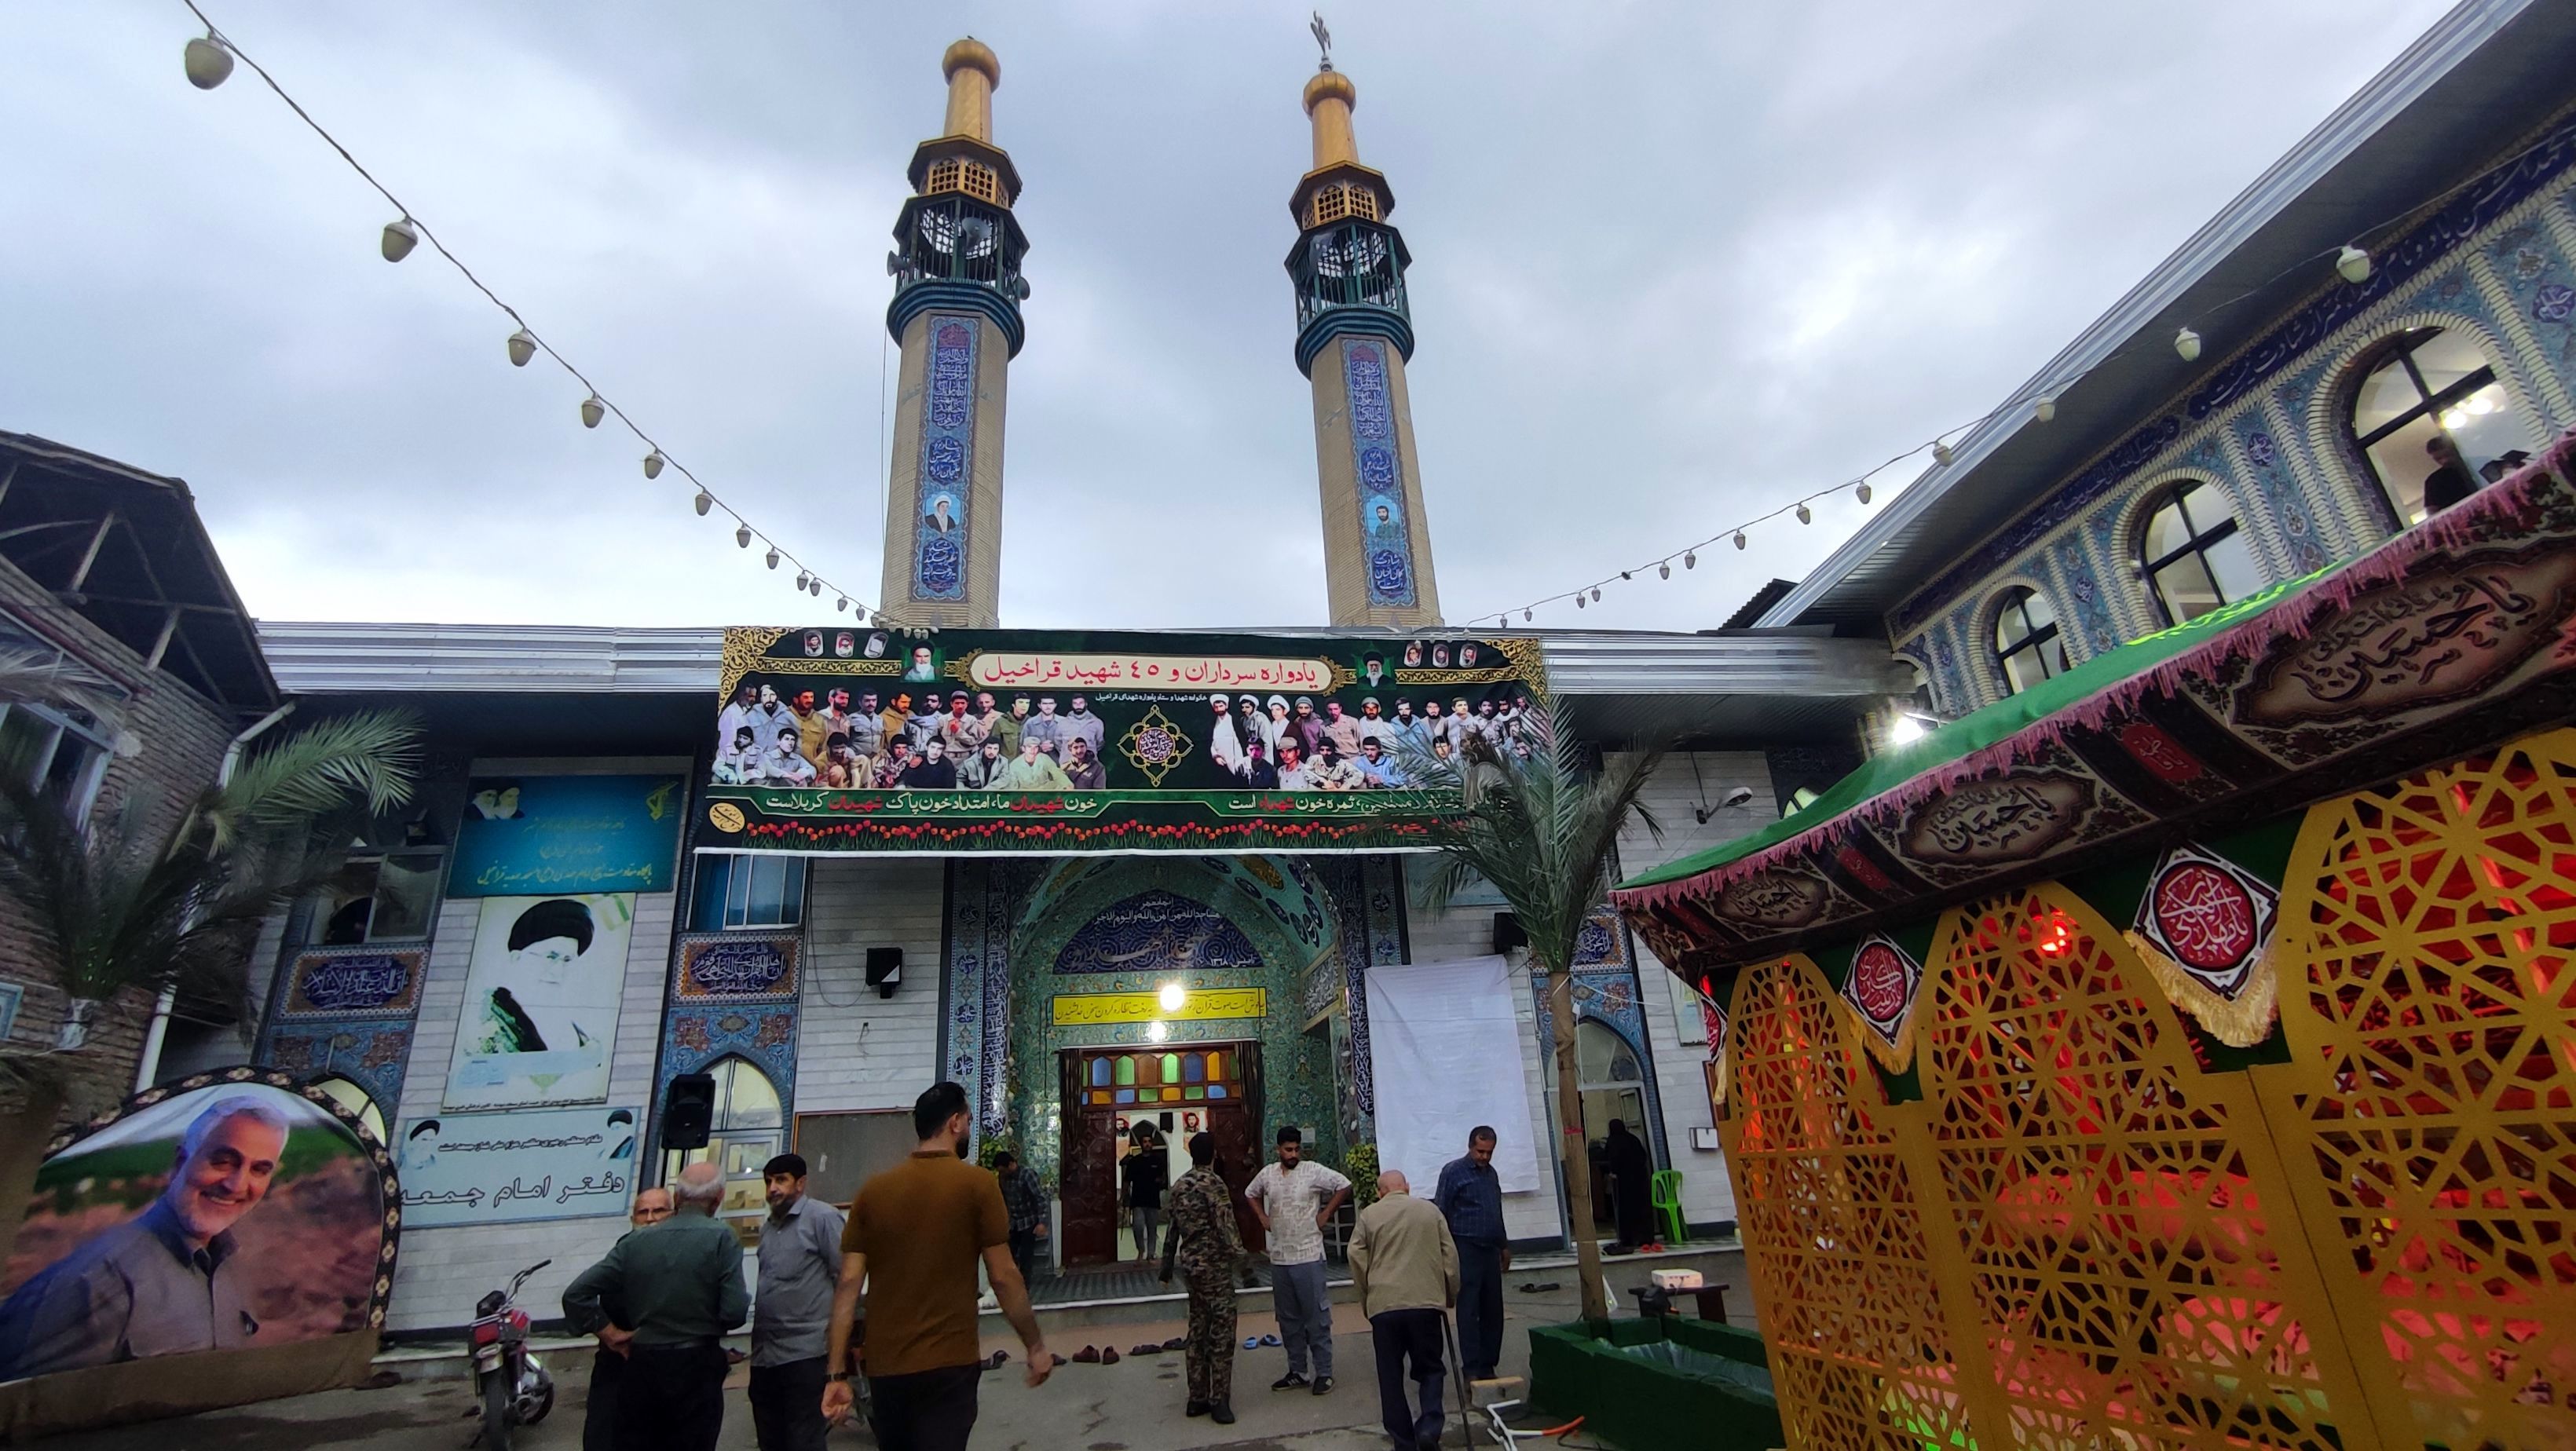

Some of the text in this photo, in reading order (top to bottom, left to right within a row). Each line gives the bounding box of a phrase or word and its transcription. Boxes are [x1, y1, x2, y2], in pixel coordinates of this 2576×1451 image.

[2291, 602, 2491, 701] حسین
[984, 656, 1062, 684] قراخیل
[1066, 660, 1122, 685] شهید
[1167, 667, 1180, 682] و
[1184, 660, 1257, 685] سرداران
[1261, 662, 1319, 689] یادواره
[1096, 692, 1118, 702] قراخیل
[766, 791, 829, 812] کربلاست
[828, 795, 884, 813] شهیدان
[886, 791, 917, 814] پاک
[919, 796, 953, 813] خون
[952, 793, 990, 811] امتداد
[1009, 795, 1065, 814] شهیدان
[1064, 796, 1097, 812] خون
[1228, 793, 1257, 810] است
[1296, 796, 1326, 813] خون
[1327, 795, 1356, 813] ثمره
[1926, 803, 2031, 853] حسین
[1212, 1000, 1231, 1011] صوت
[400, 1171, 625, 1209] دفتر امام جمعه
